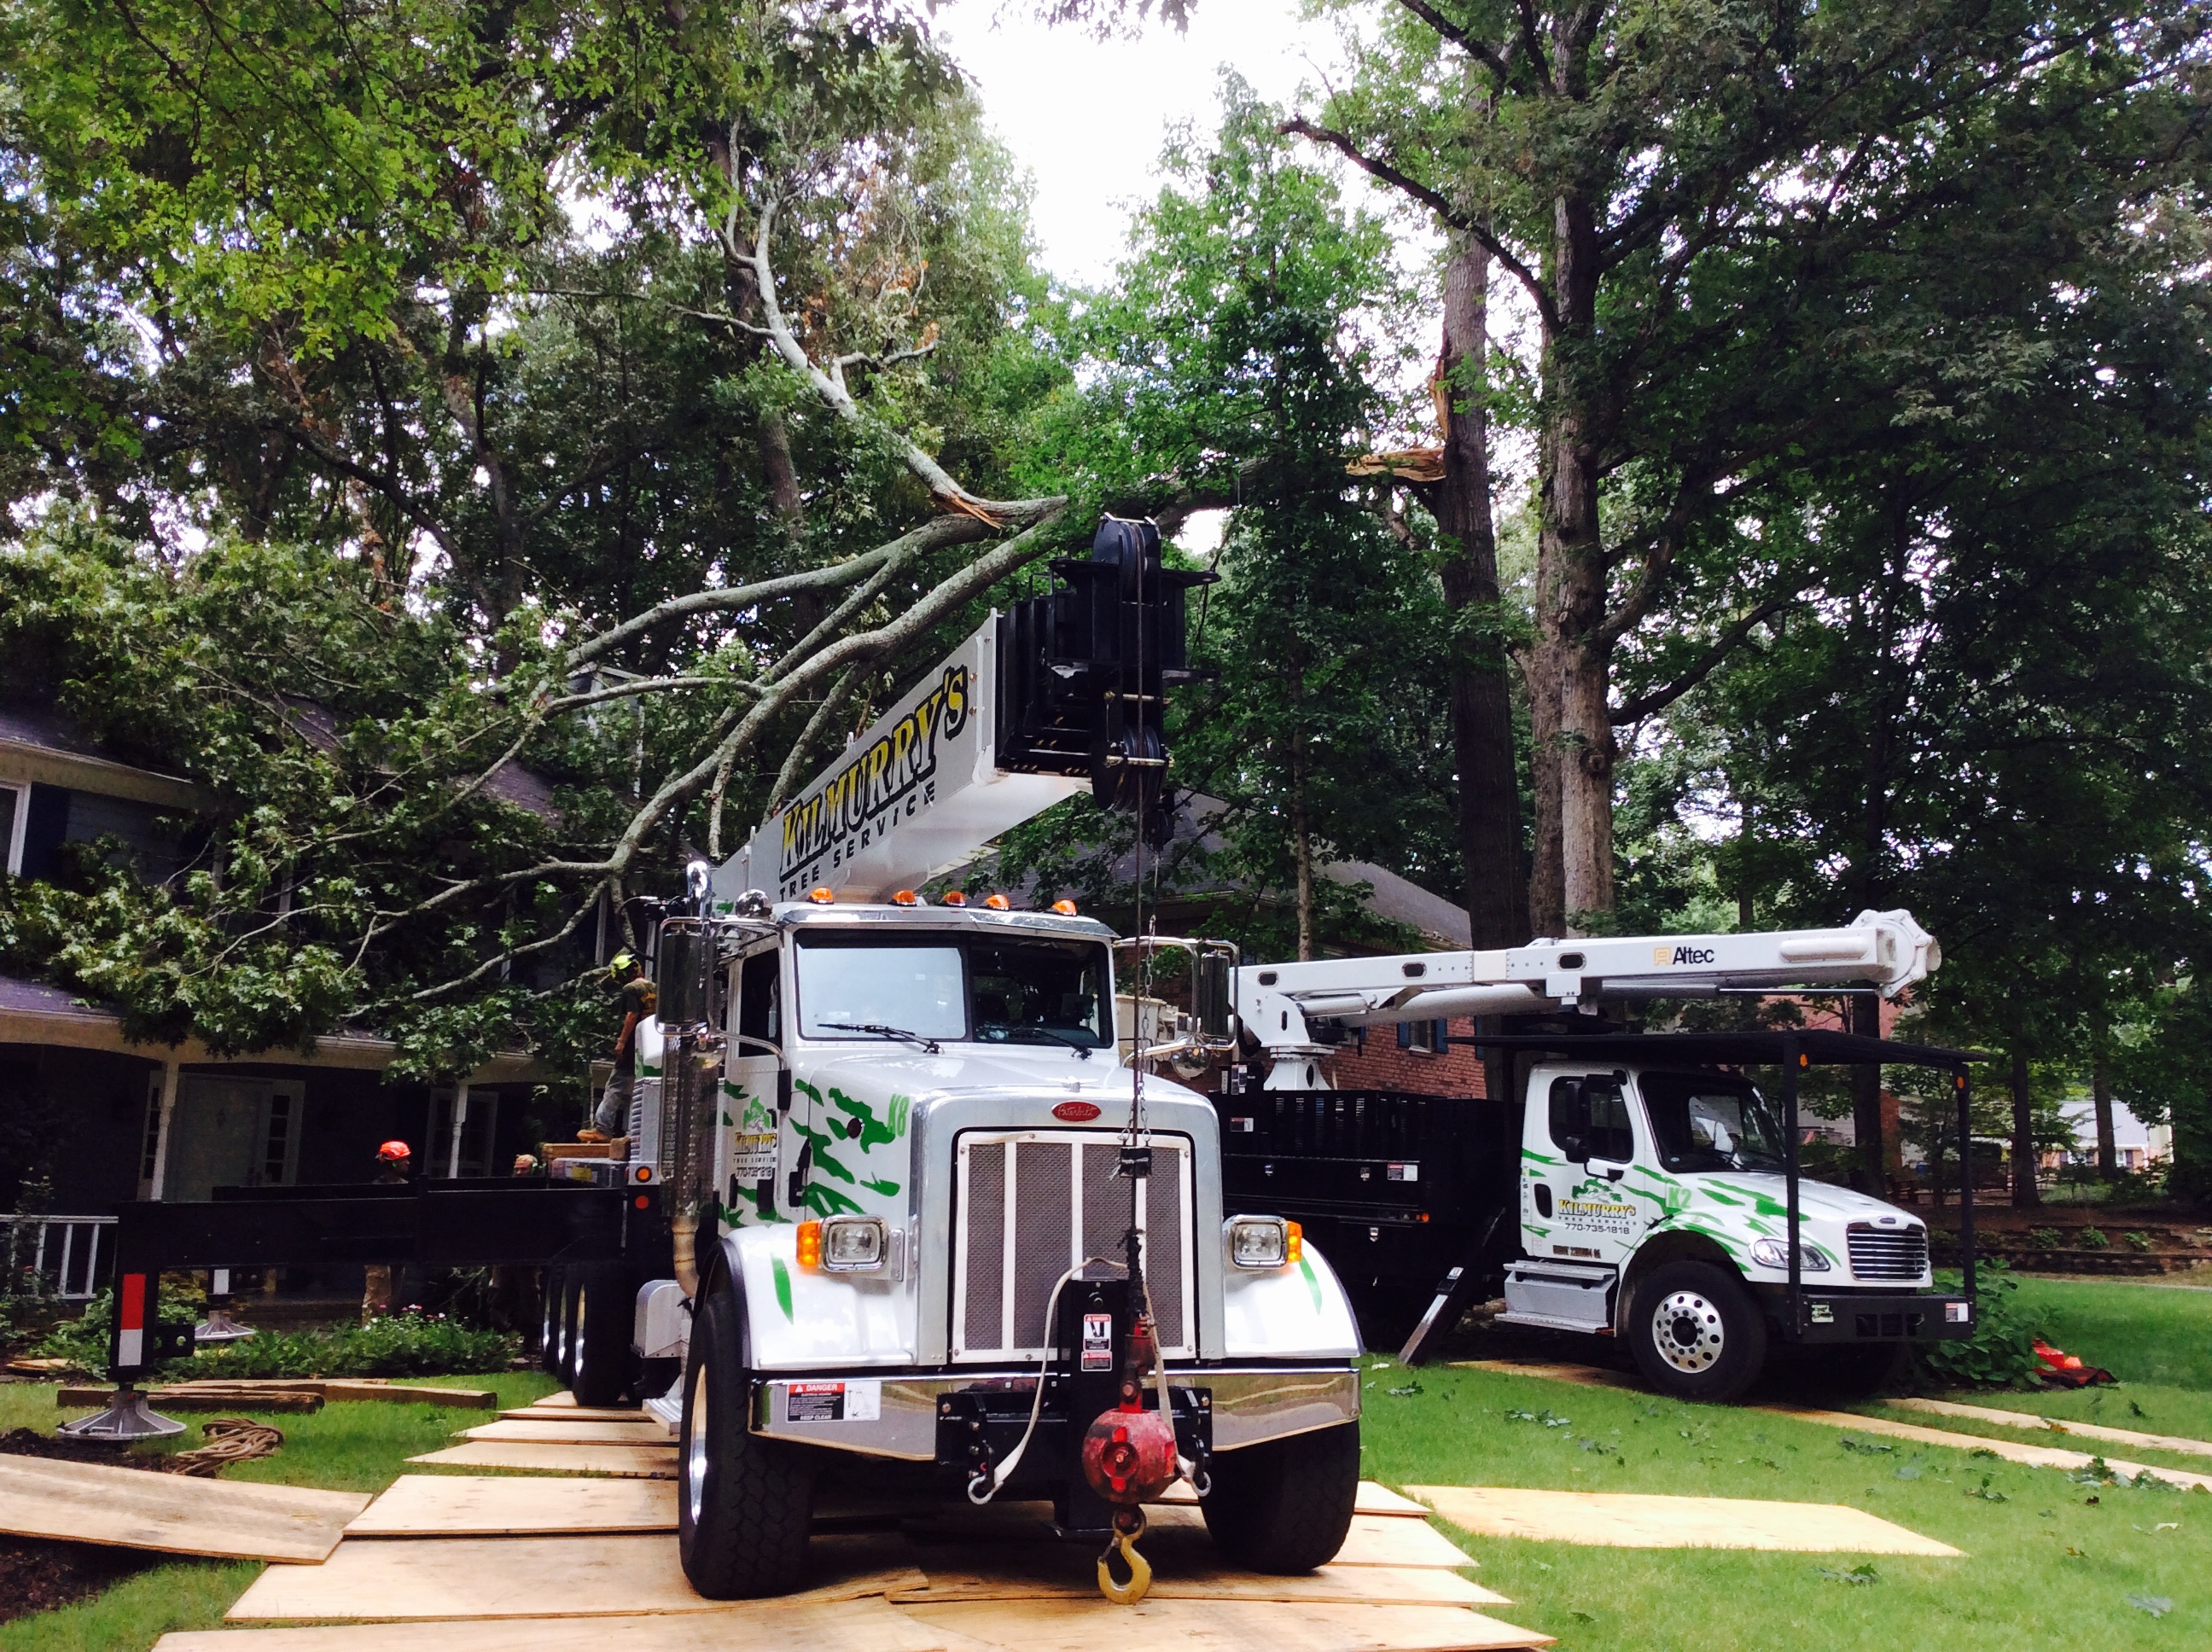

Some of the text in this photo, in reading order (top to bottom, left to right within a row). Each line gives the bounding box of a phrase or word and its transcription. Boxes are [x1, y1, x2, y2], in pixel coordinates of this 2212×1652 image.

[779, 664, 969, 883] KILMURRY'S
[779, 780, 935, 902] TREE SERVICE
[1673, 946, 1714, 965] Altec
[1669, 1187, 1691, 1208] K2
[1558, 1199, 1637, 1219] KILMURRY'S
[1565, 1223, 1630, 1235] 770-735-1818
[806, 1383, 838, 1392] DANGER
